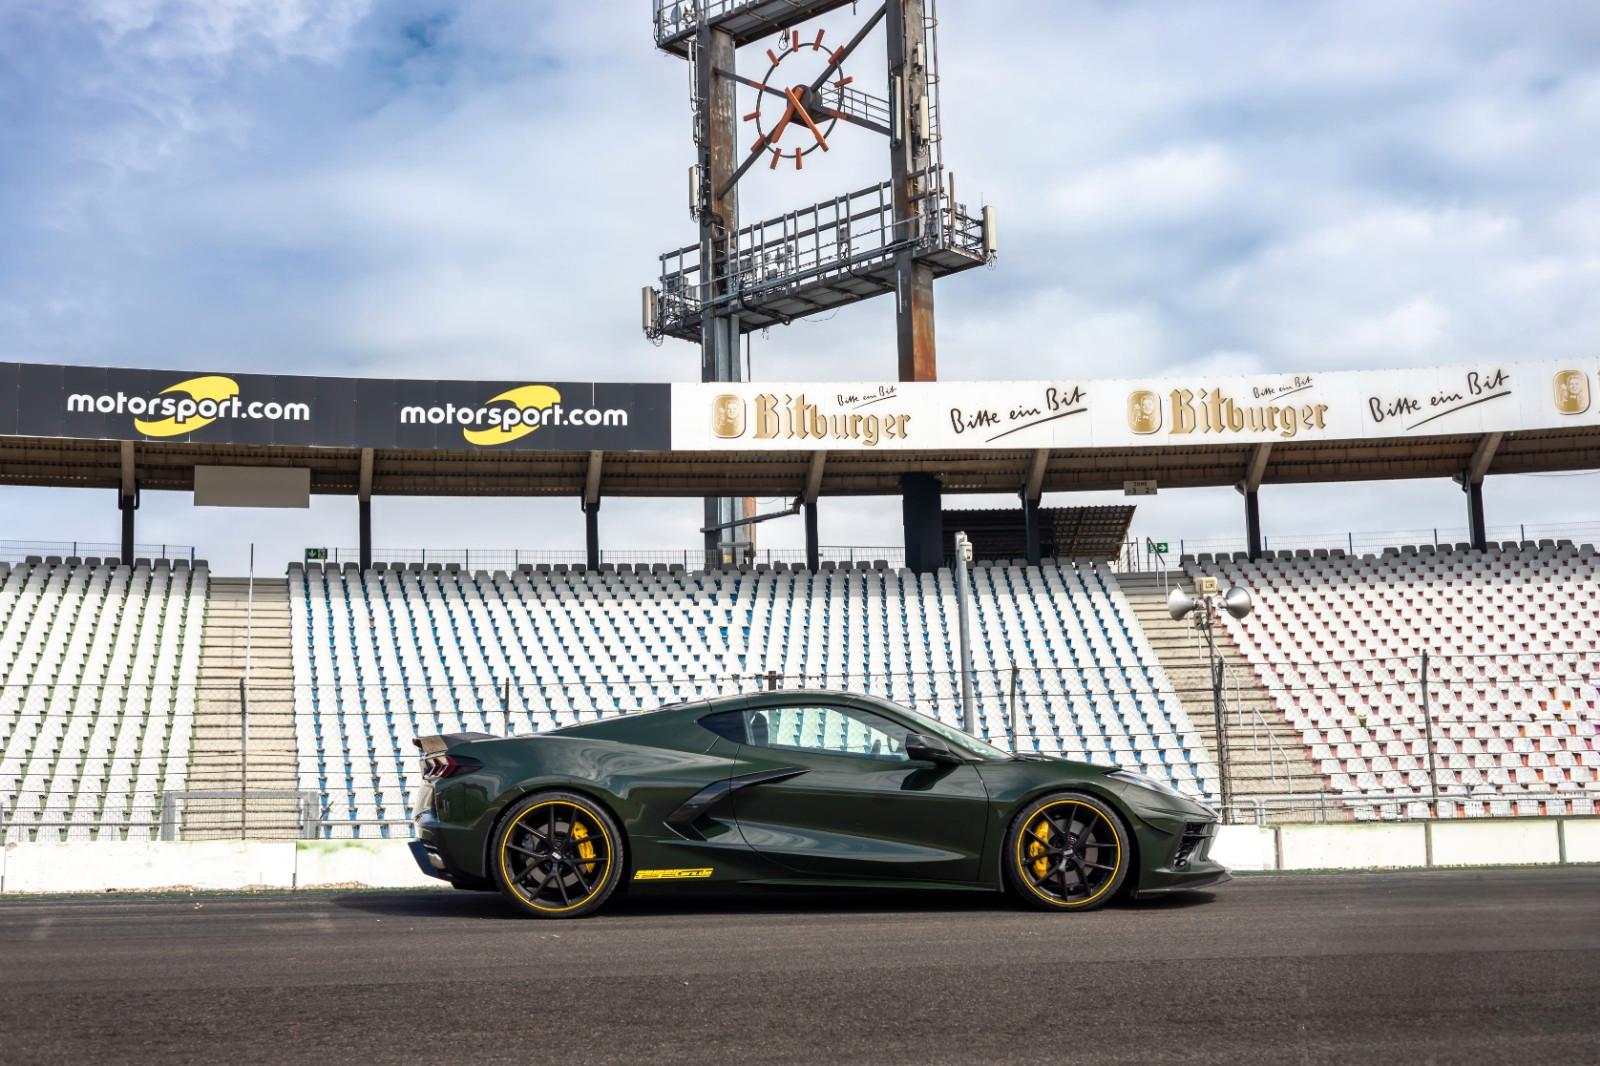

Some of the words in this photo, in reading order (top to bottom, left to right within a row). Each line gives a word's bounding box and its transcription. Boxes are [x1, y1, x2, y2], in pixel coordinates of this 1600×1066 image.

[67, 391, 310, 422] motorsport.com
[400, 403, 628, 431] motorsport.com
[752, 393, 911, 446] Bitburger
[950, 408, 1000, 433] Bitte
[1009, 405, 1040, 420] ein
[1046, 386, 1087, 411] Bit
[1168, 387, 1328, 437] Bitburger
[1369, 397, 1421, 422] Bitte
[1431, 391, 1462, 406] ein
[1467, 369, 1510, 395] Bit
